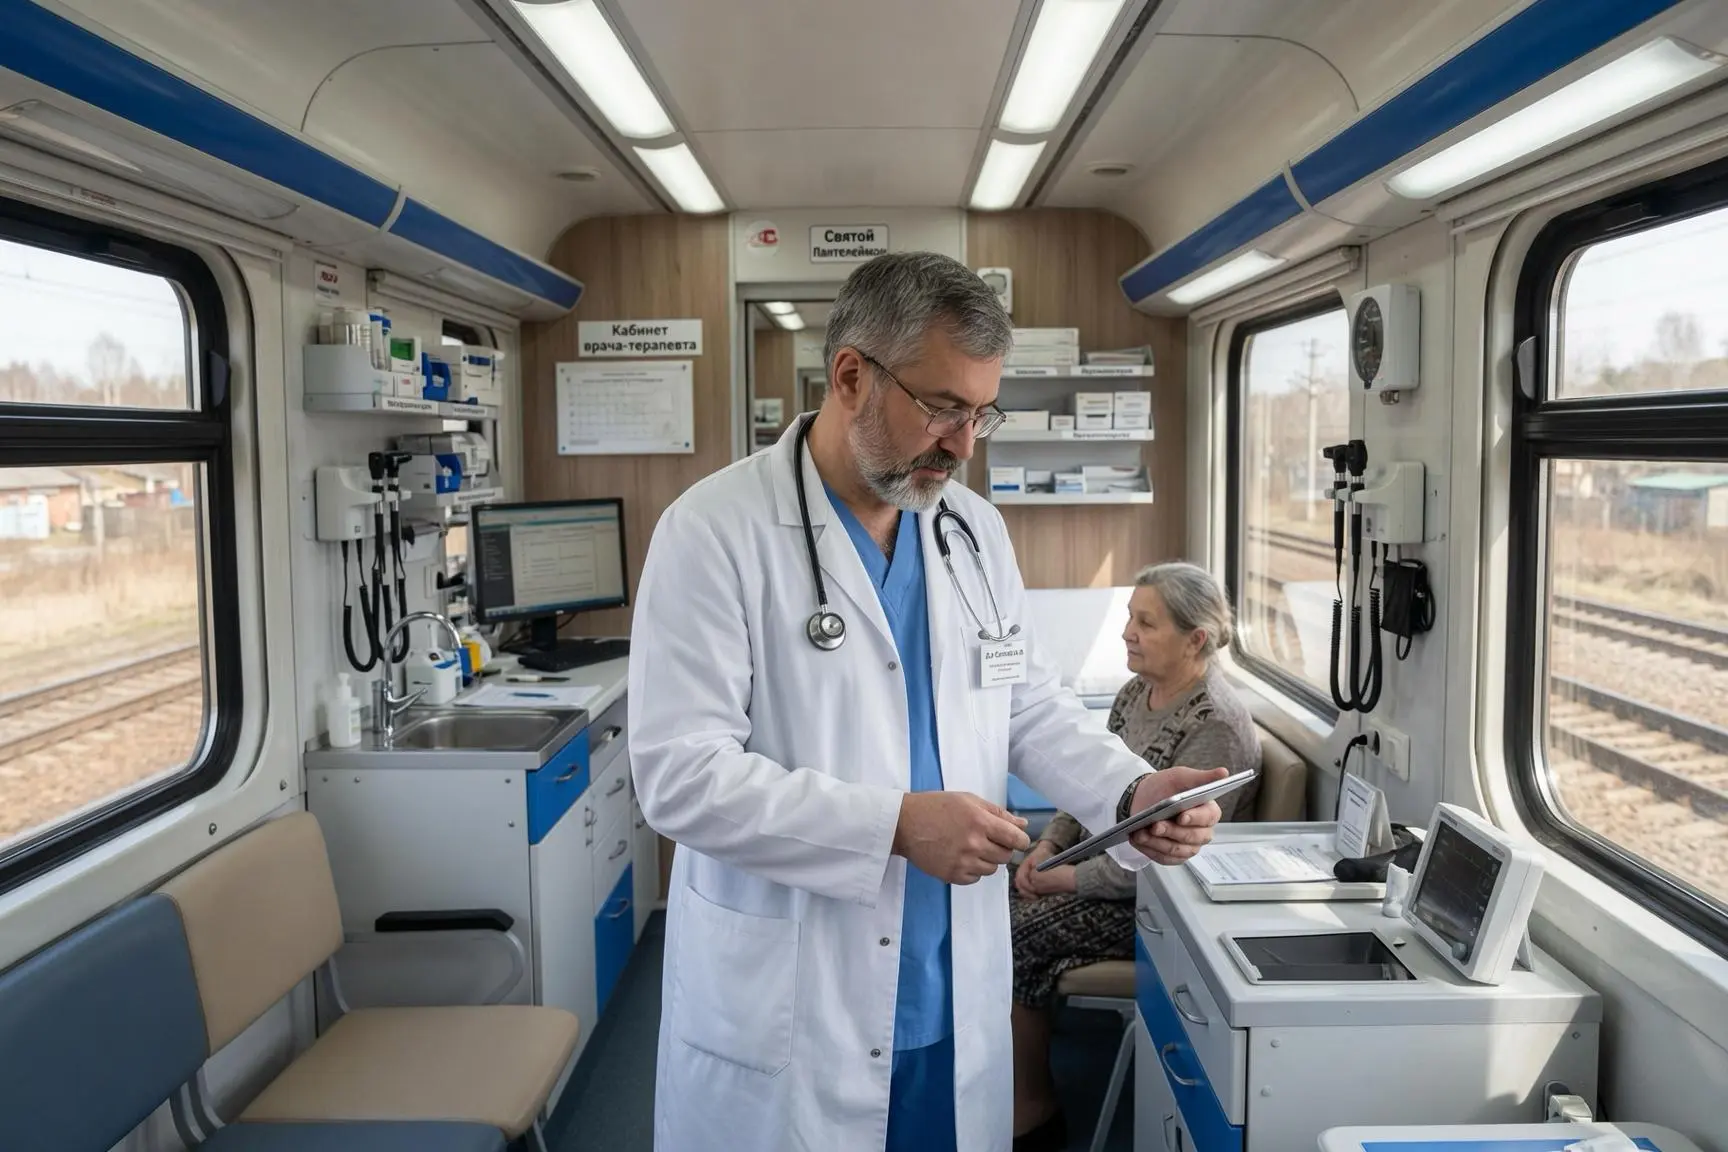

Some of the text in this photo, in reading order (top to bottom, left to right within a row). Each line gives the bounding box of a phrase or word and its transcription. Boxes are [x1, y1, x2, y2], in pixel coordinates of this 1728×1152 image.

[824, 229, 874, 243] Святой
[612, 324, 668, 336] Кабинет
[584, 341, 697, 354] врача-терапевта
